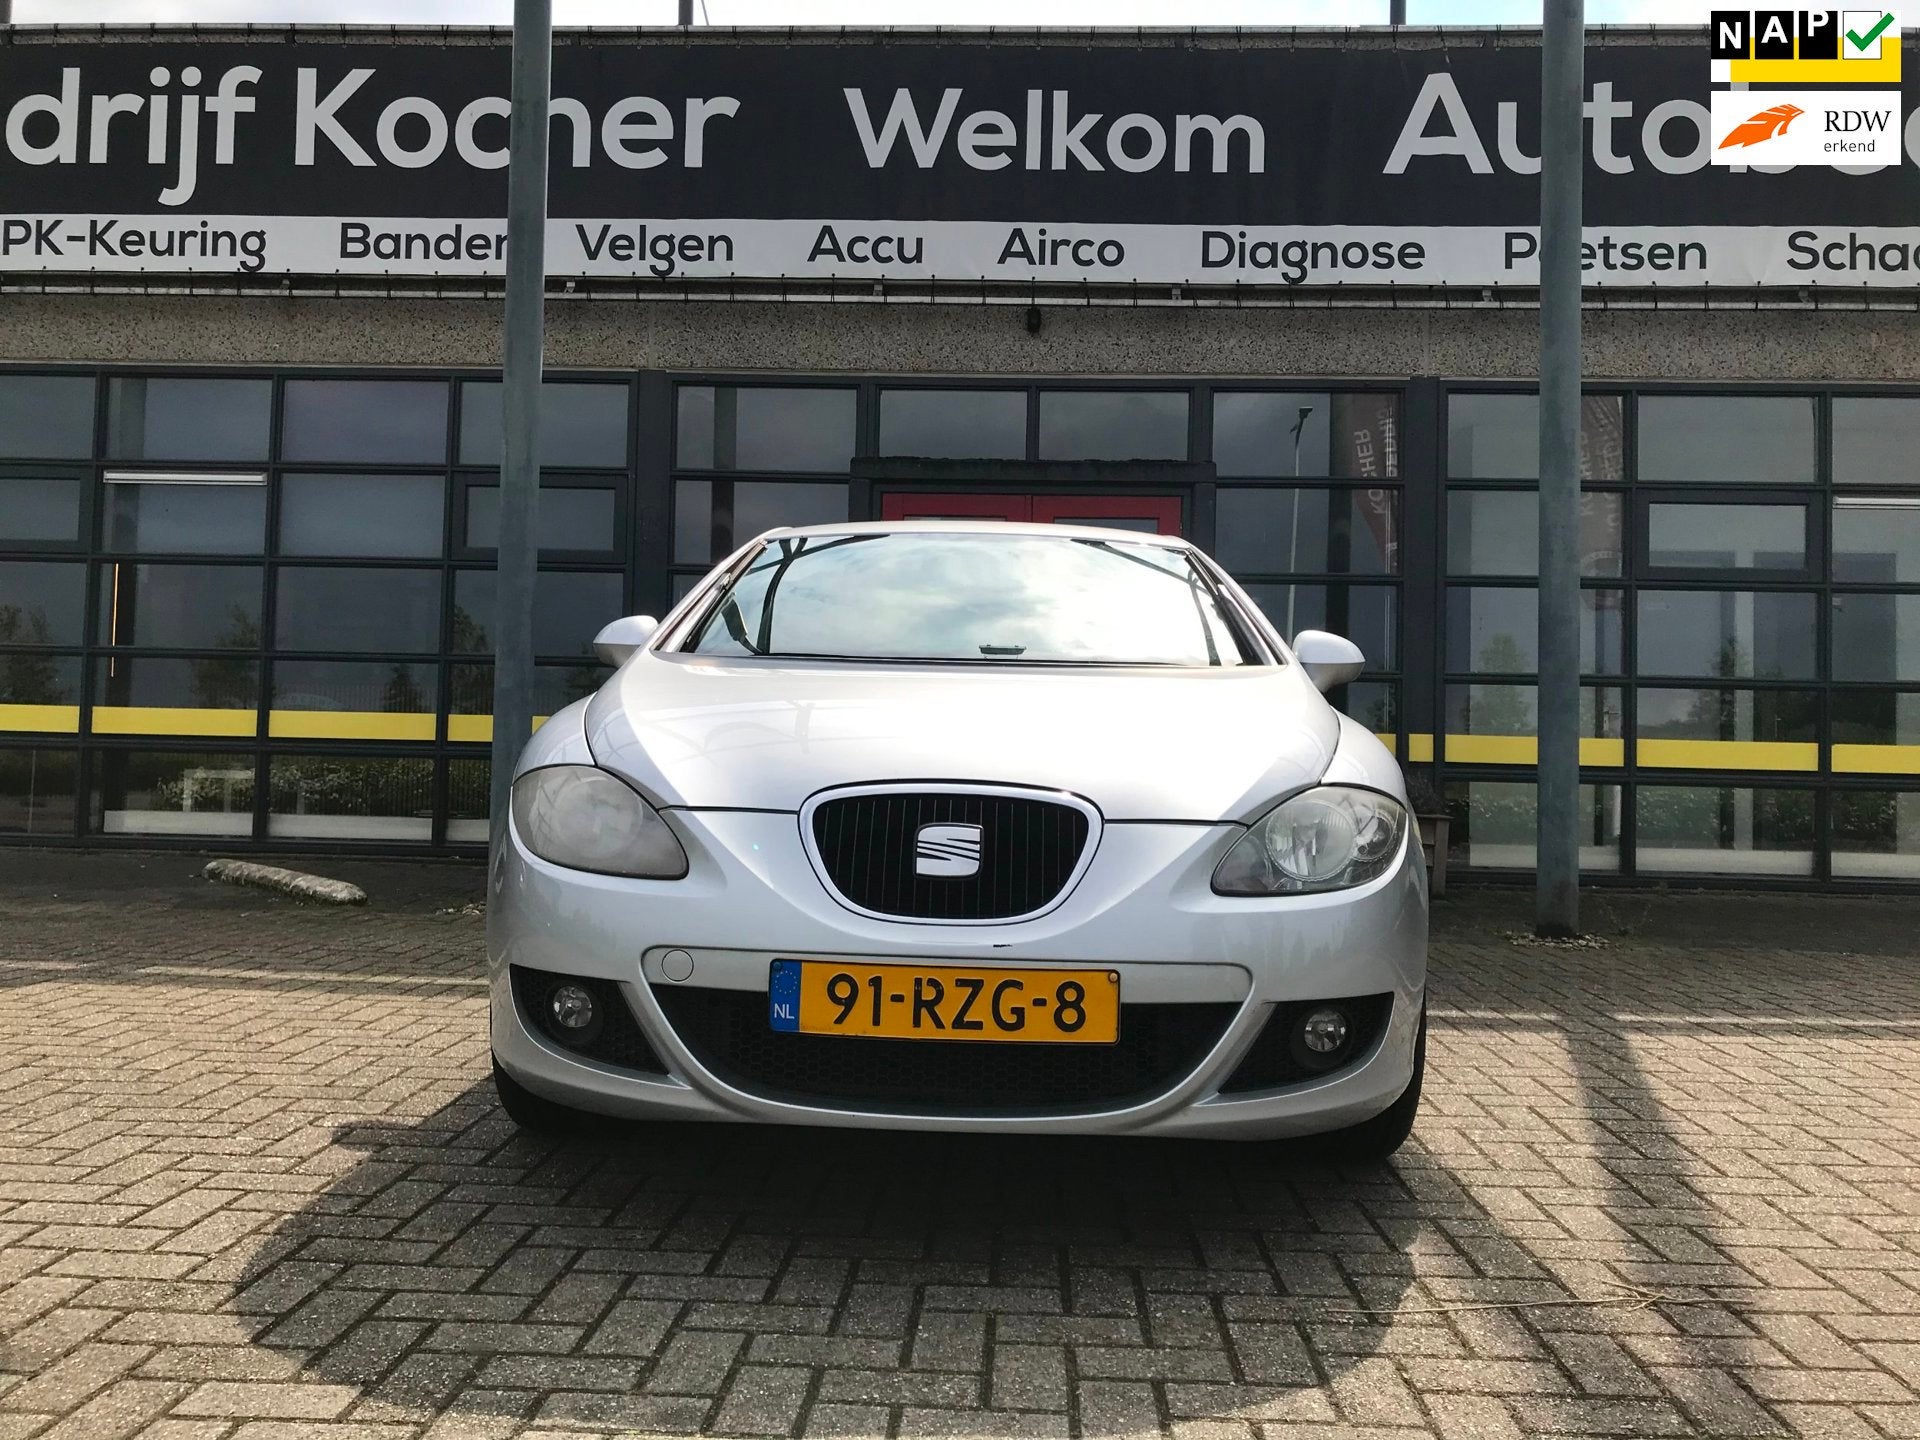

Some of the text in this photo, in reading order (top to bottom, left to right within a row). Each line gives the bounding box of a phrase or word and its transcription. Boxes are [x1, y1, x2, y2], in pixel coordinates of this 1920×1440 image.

[6, 66, 262, 206] drijf
[844, 88, 1264, 173] Welkom
[1383, 73, 1920, 175] Auto
[3, 220, 266, 273] PK-Keuring
[576, 224, 733, 277] Velgen
[807, 225, 923, 264] Accu
[997, 228, 1124, 267] Airco
[1202, 231, 1425, 285] Diagnose
[1505, 232, 1706, 270] Petsen
[1787, 231, 1920, 271] Scha
[774, 973, 1086, 1033] NL 91-RZG-8
